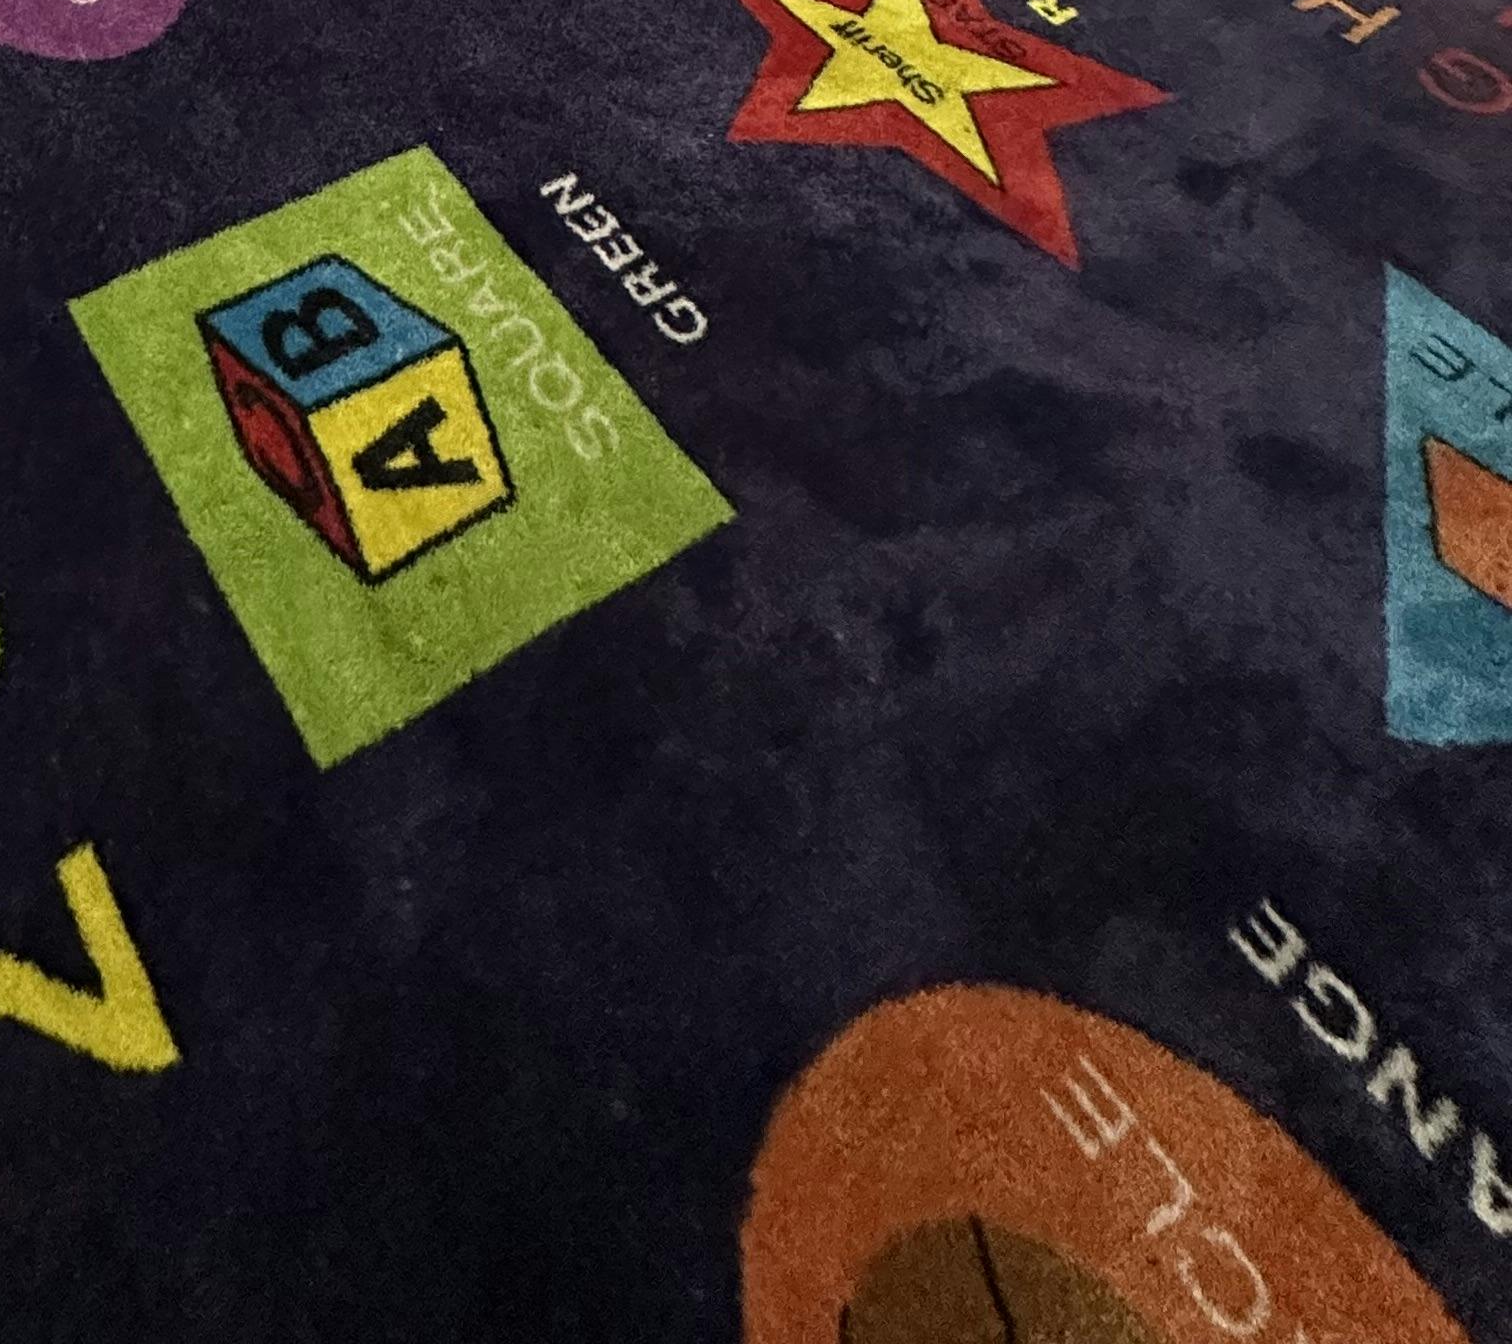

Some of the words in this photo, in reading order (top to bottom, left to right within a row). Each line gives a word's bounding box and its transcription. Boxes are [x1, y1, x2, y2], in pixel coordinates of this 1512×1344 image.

[826, 19, 946, 107] Sheriff
[540, 172, 709, 346] GREEN
[262, 286, 380, 380] B
[397, 182, 622, 463] SQUARE
[351, 395, 486, 493] A
